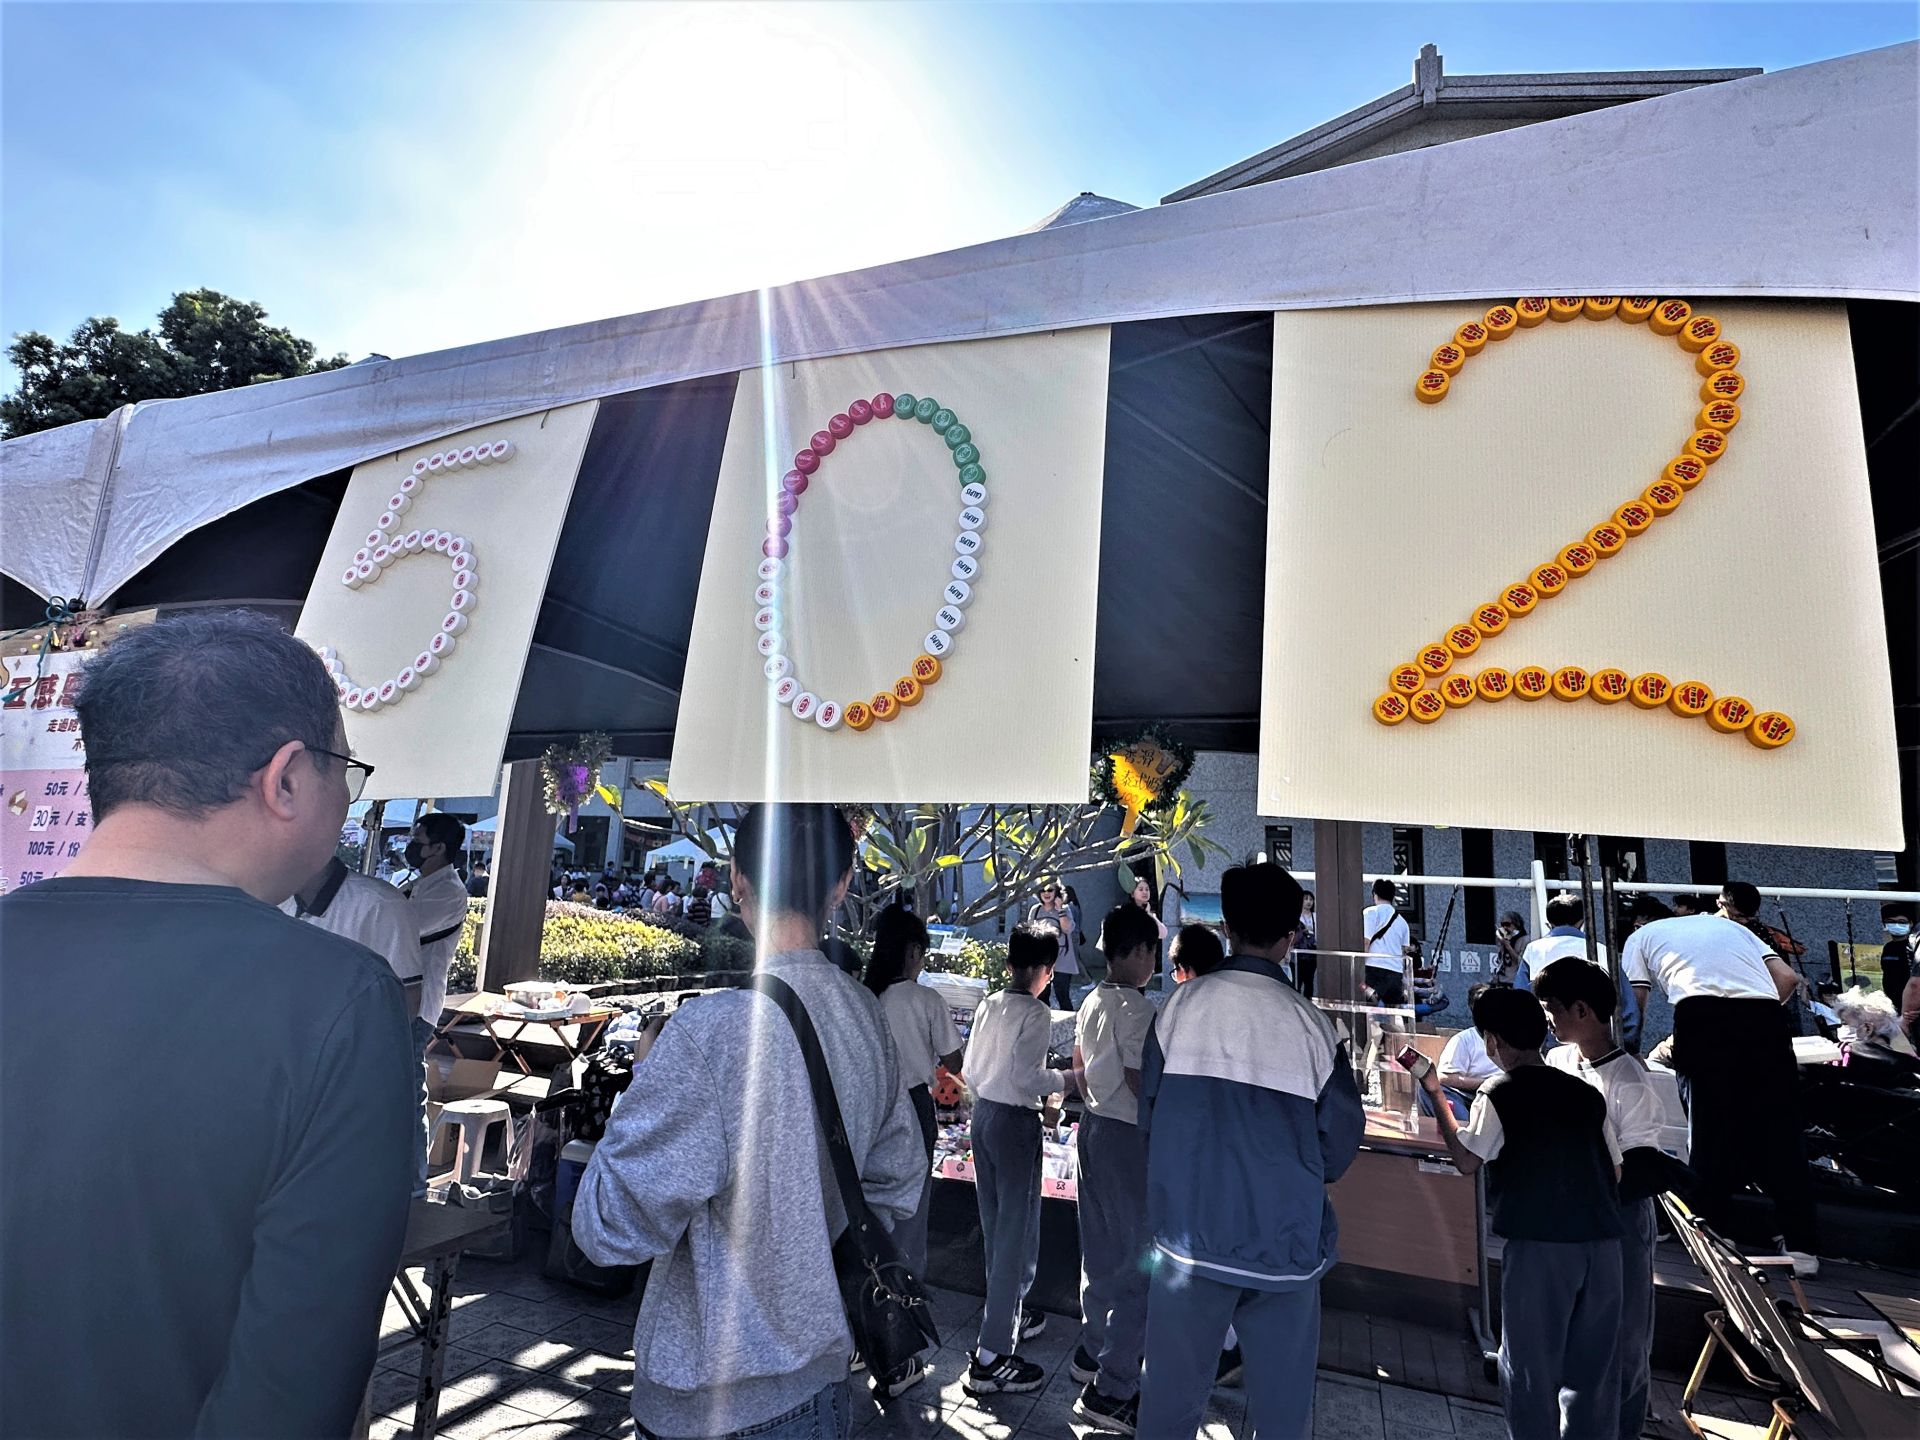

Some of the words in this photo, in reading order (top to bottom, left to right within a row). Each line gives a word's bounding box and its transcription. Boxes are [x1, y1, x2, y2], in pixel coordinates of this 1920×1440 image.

[46, 719, 84, 732] 走過路
[45, 781, 69, 796] 50元
[33, 810, 60, 827] 30元
[75, 811, 88, 826] 支
[28, 841, 54, 855] 100元
